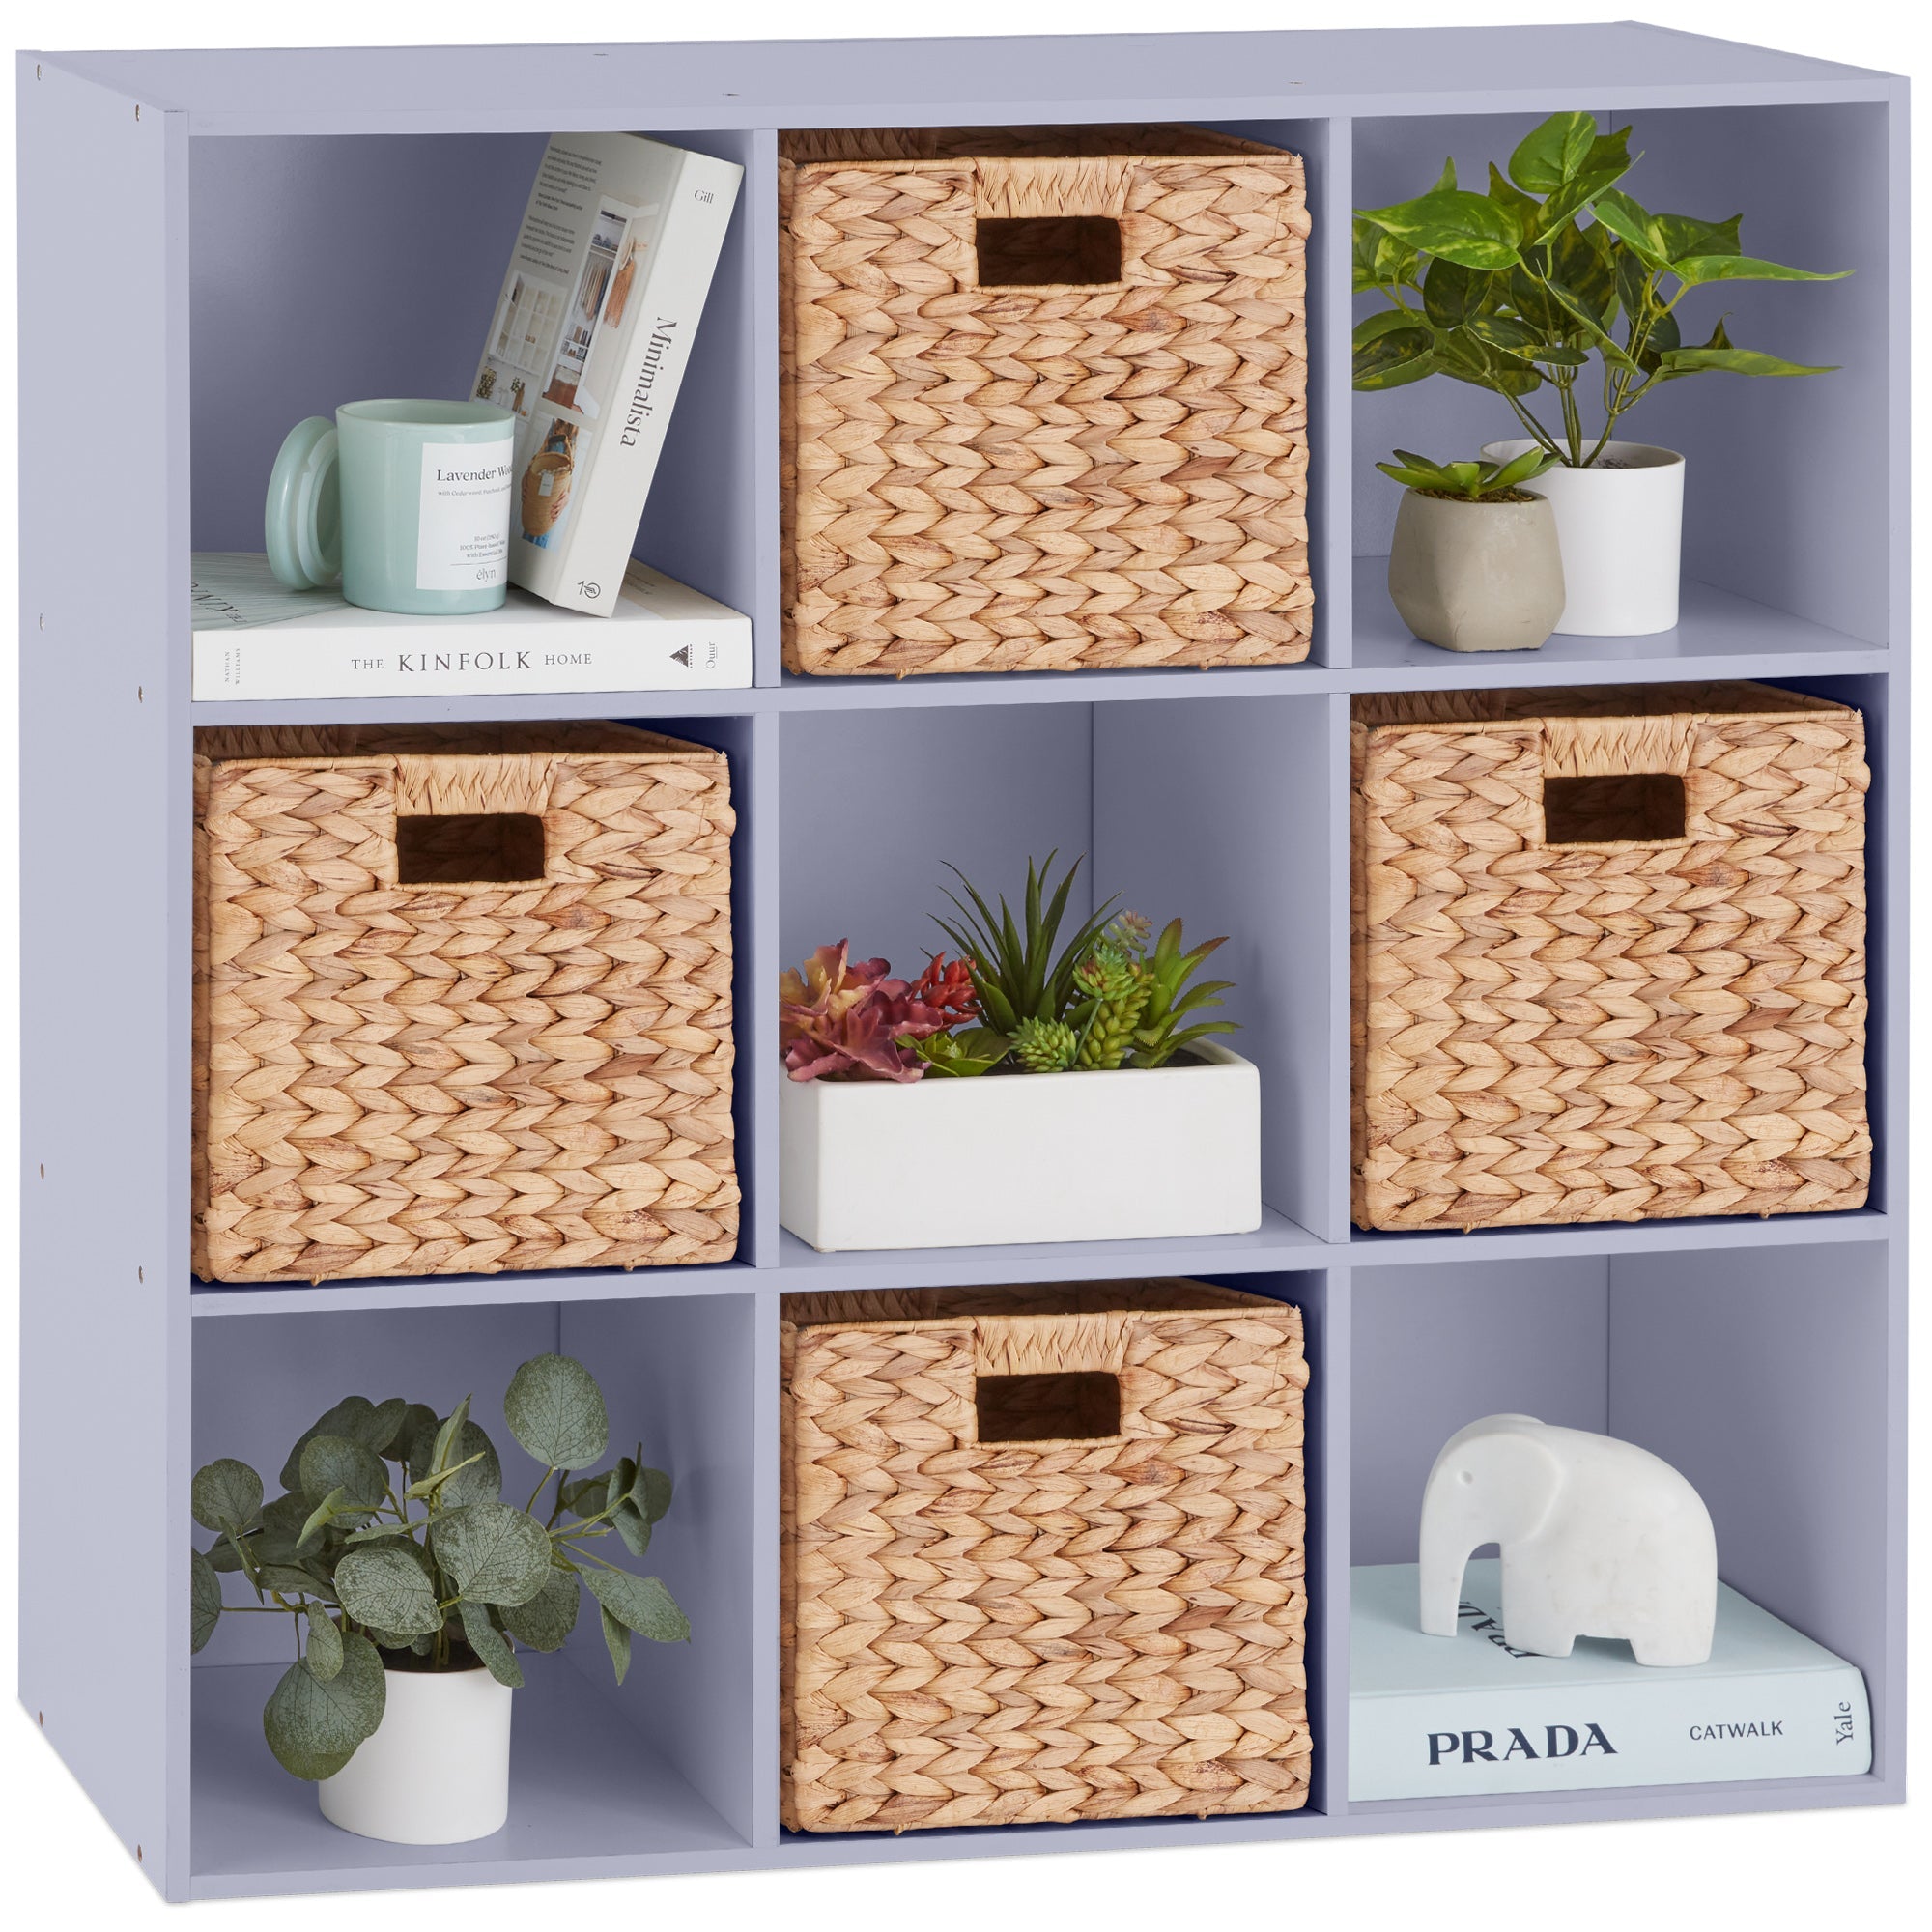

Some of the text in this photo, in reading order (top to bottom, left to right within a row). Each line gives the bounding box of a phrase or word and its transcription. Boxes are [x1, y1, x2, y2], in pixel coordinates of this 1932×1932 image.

[694, 188, 714, 204] Gill
[619, 316, 678, 447] Minimalista
[436, 468, 497, 482] Lavender
[351, 651, 593, 672] THE KINFOLK HOME
[1833, 1701, 1854, 1746] Yale
[1427, 1720, 1783, 1766] PRADA CATWALK
